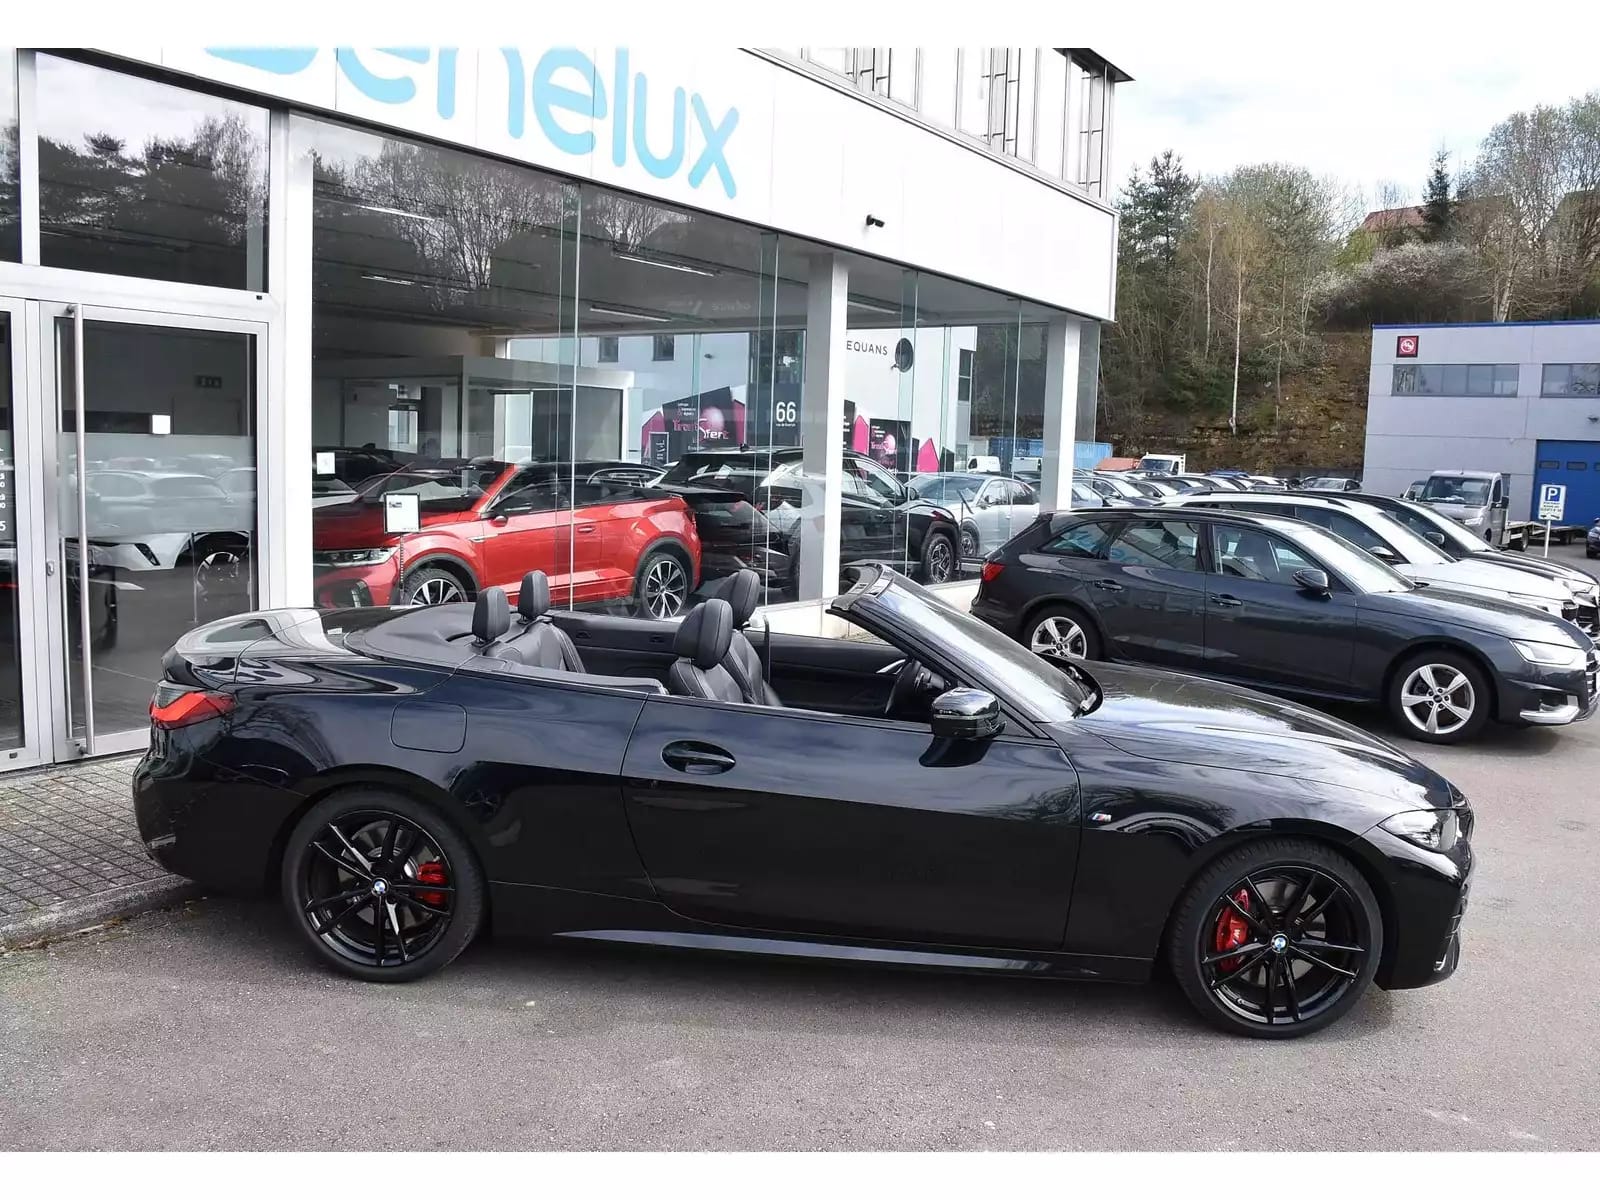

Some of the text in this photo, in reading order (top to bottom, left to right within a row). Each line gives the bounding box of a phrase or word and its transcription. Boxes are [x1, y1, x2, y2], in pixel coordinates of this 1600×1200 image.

[203, 47, 740, 199] enelux
[846, 340, 888, 356] EQUANS
[776, 401, 796, 422] 66
[1547, 487, 1558, 500] P
